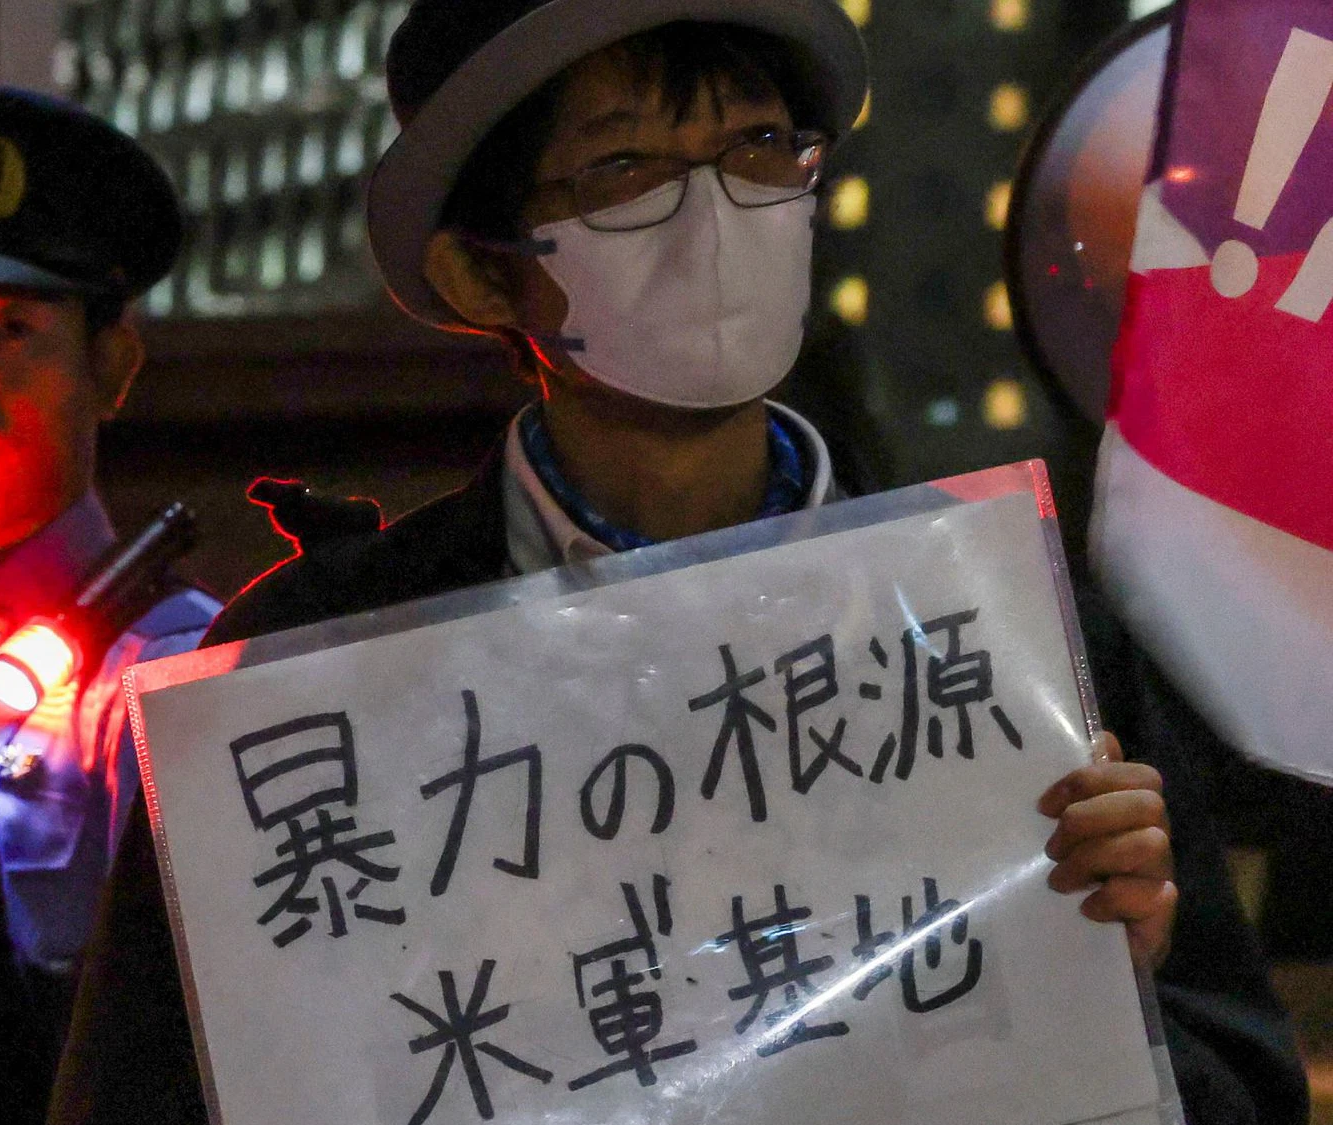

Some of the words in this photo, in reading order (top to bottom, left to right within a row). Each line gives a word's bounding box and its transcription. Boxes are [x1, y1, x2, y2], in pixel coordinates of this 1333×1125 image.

[229, 607, 1023, 948] 暴力の根源
